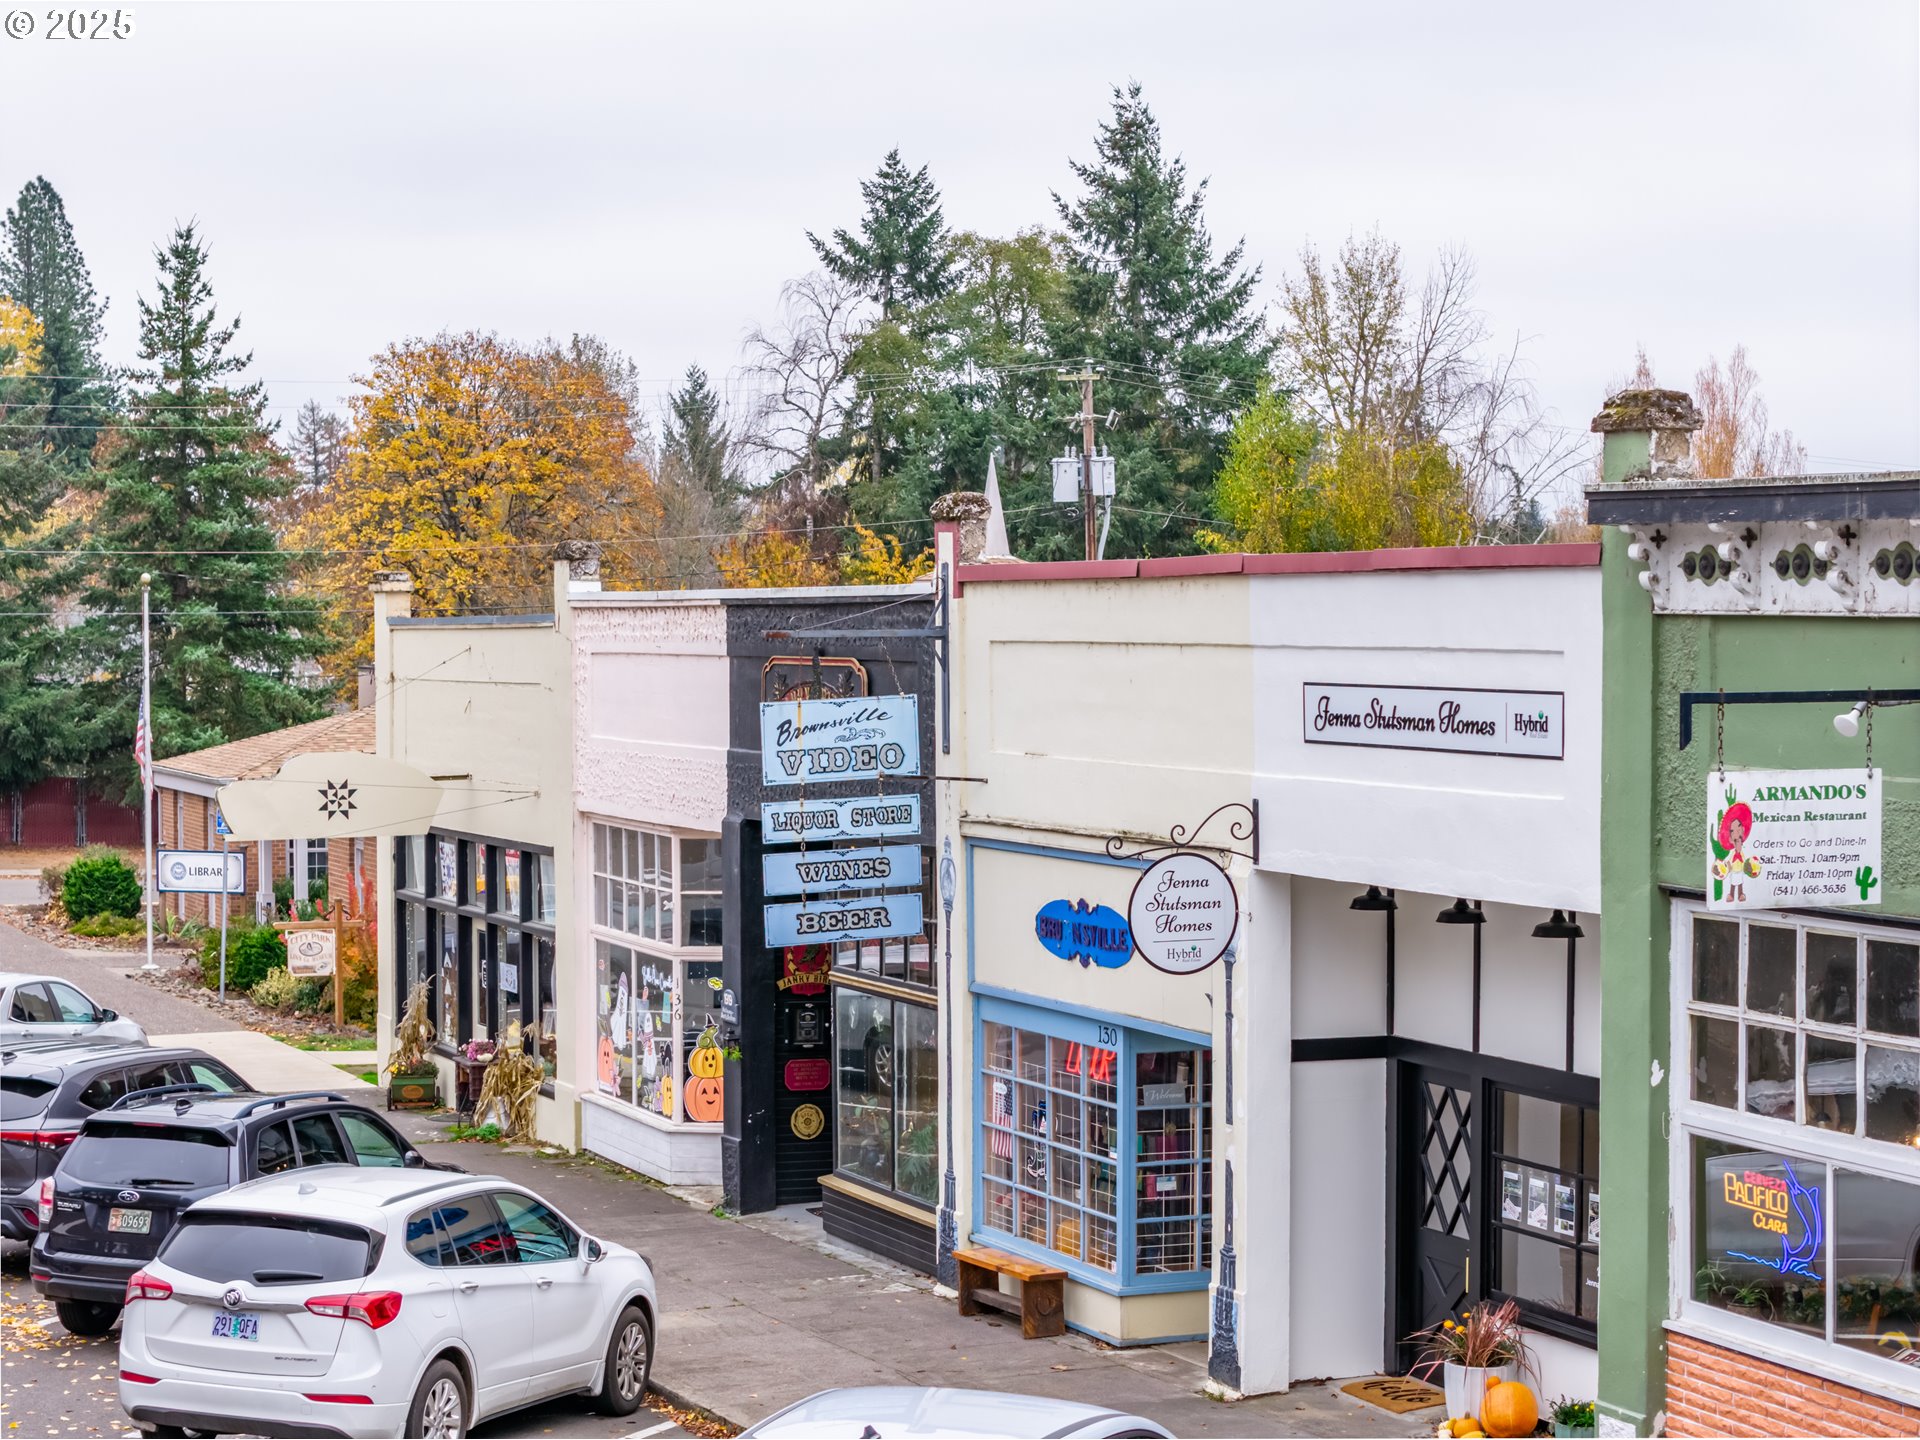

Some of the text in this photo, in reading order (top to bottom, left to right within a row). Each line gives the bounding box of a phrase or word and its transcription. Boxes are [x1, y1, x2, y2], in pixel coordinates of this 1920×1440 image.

[1314, 696, 1496, 736] Jenna Stutsman Homes
[1514, 711, 1548, 736] Hybrid
[776, 708, 893, 747] Brownsville
[777, 743, 905, 776] VIDEO
[1752, 784, 1867, 801] ARMANDO'S
[772, 805, 912, 834] LIQUOR STORE
[1752, 811, 1867, 823] Mexican Restaurant
[1752, 837, 1867, 849] Orders to Go and Dine-In
[1811, 853, 1860, 864] 10am-9pm
[188, 866, 228, 877] LIBRAR
[797, 857, 891, 883] WINES
[1766, 869, 1853, 882] Friday 10am-10pm
[1157, 870, 1210, 892] Jenna
[1773, 884, 1846, 897] (541) 466-3636
[1145, 893, 1222, 912] Stutsman
[797, 907, 892, 935] BEER
[1155, 914, 1213, 934] Homes
[1167, 945, 1202, 962] Hybrid
[1098, 1025, 1118, 1046] 130
[1724, 1172, 1789, 1214] PACIFICO
[1752, 1211, 1788, 1235] CLARA
[214, 1316, 232, 1332] 291
